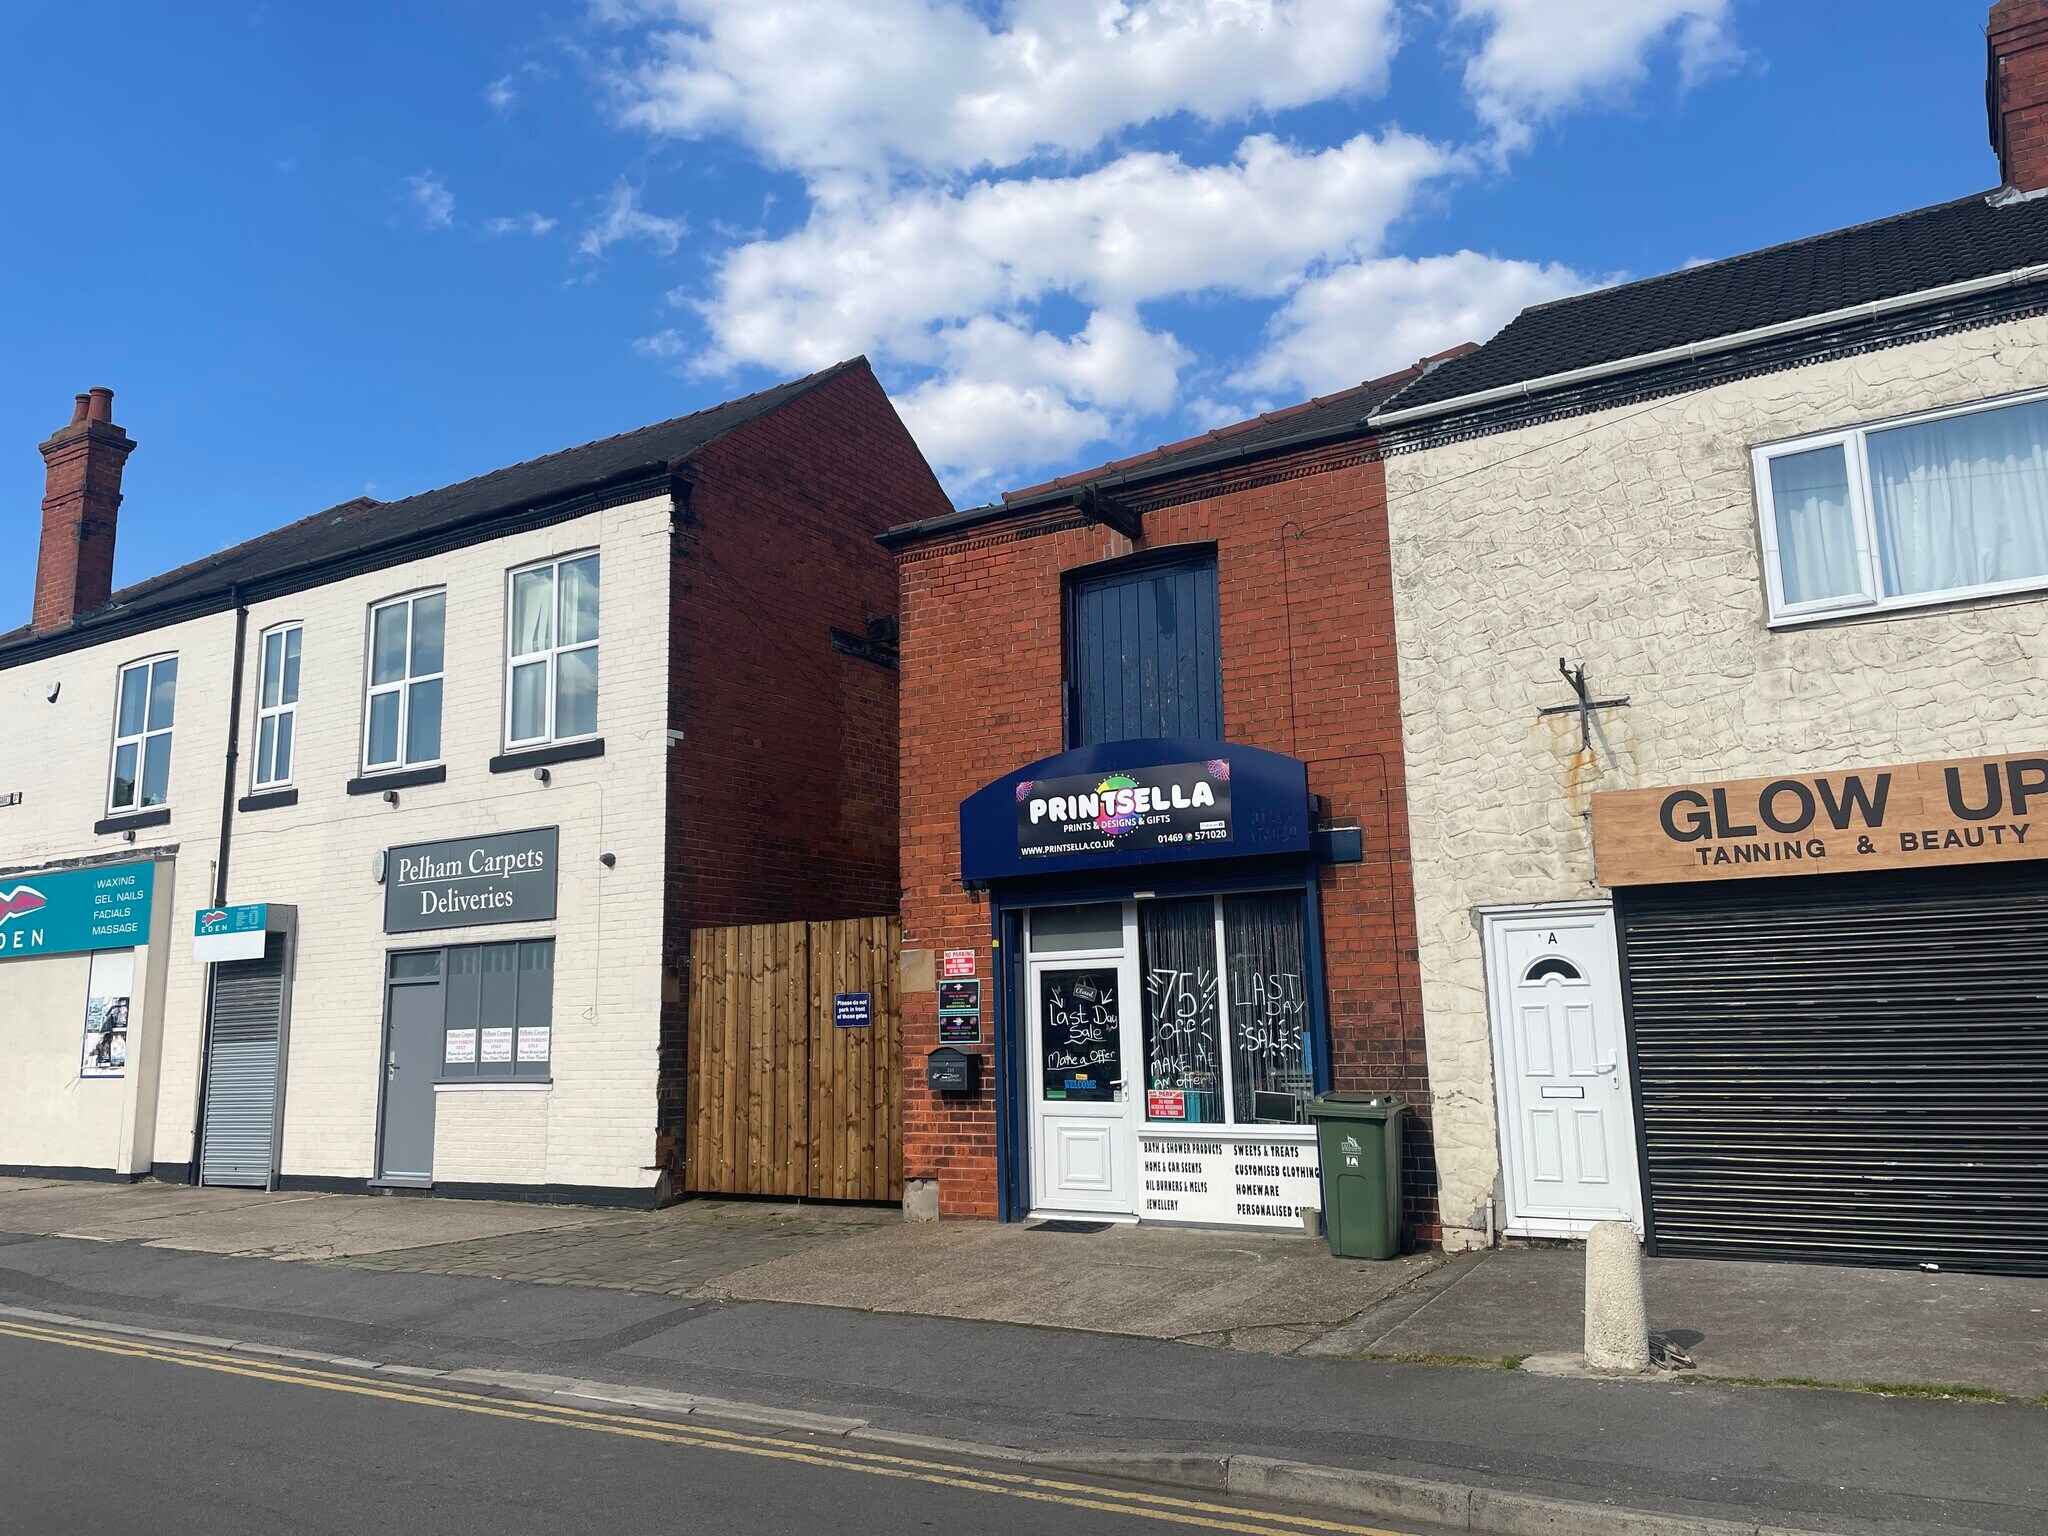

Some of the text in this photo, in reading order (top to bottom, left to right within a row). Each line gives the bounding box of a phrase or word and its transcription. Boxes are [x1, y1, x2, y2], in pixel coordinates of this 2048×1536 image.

[1029, 781, 1215, 825] PRINTSELLA
[1659, 757, 2048, 842] GLOW UP
[1063, 814, 1170, 833] PRINTS & DESIGNS & GIFTS
[1157, 829, 1227, 843] 01469 571020
[1020, 839, 1115, 856] WWW.PRINTSELLA.CO.UK
[1696, 823, 2030, 866] TANNING & BEAUTY
[397, 848, 544, 882] Pelham Carpets
[97, 875, 136, 889] WAXING
[95, 890, 144, 905] GEL NAILS
[420, 886, 513, 915] Deliveries
[93, 907, 131, 920] FACIALS
[92, 922, 138, 936] MASSAGE
[201, 924, 228, 933] EDEN
[1548, 932, 1557, 945] A
[952, 950, 974, 958] PARKING
[1075, 987, 1094, 998] Closed
[1235, 972, 1300, 1006] LAST
[1265, 1000, 1305, 1016] DAY
[1049, 1003, 1118, 1030] Last Day
[1069, 1024, 1104, 1040] Sale
[1245, 1026, 1295, 1051] SALE
[1047, 1049, 1078, 1069] Make
[1089, 1049, 1115, 1064] Offer
[1150, 1053, 1190, 1077] MAKE
[1064, 1080, 1097, 1089] WELCOME
[1144, 1142, 1223, 1155] BATH & SHOWER PRODUCTS
[1233, 1145, 1299, 1158] SWEETS & TREATS
[1144, 1161, 1202, 1174] HOME & CAR SCENTS
[1235, 1164, 1320, 1178] CUSTOMISED CLOTHING
[1146, 1180, 1208, 1193] OIL BURNERS & MELTS
[1236, 1184, 1280, 1196] HOMEWARE
[1146, 1199, 1178, 1211] JEWELLERY
[1237, 1203, 1292, 1217] PERSONALISED
